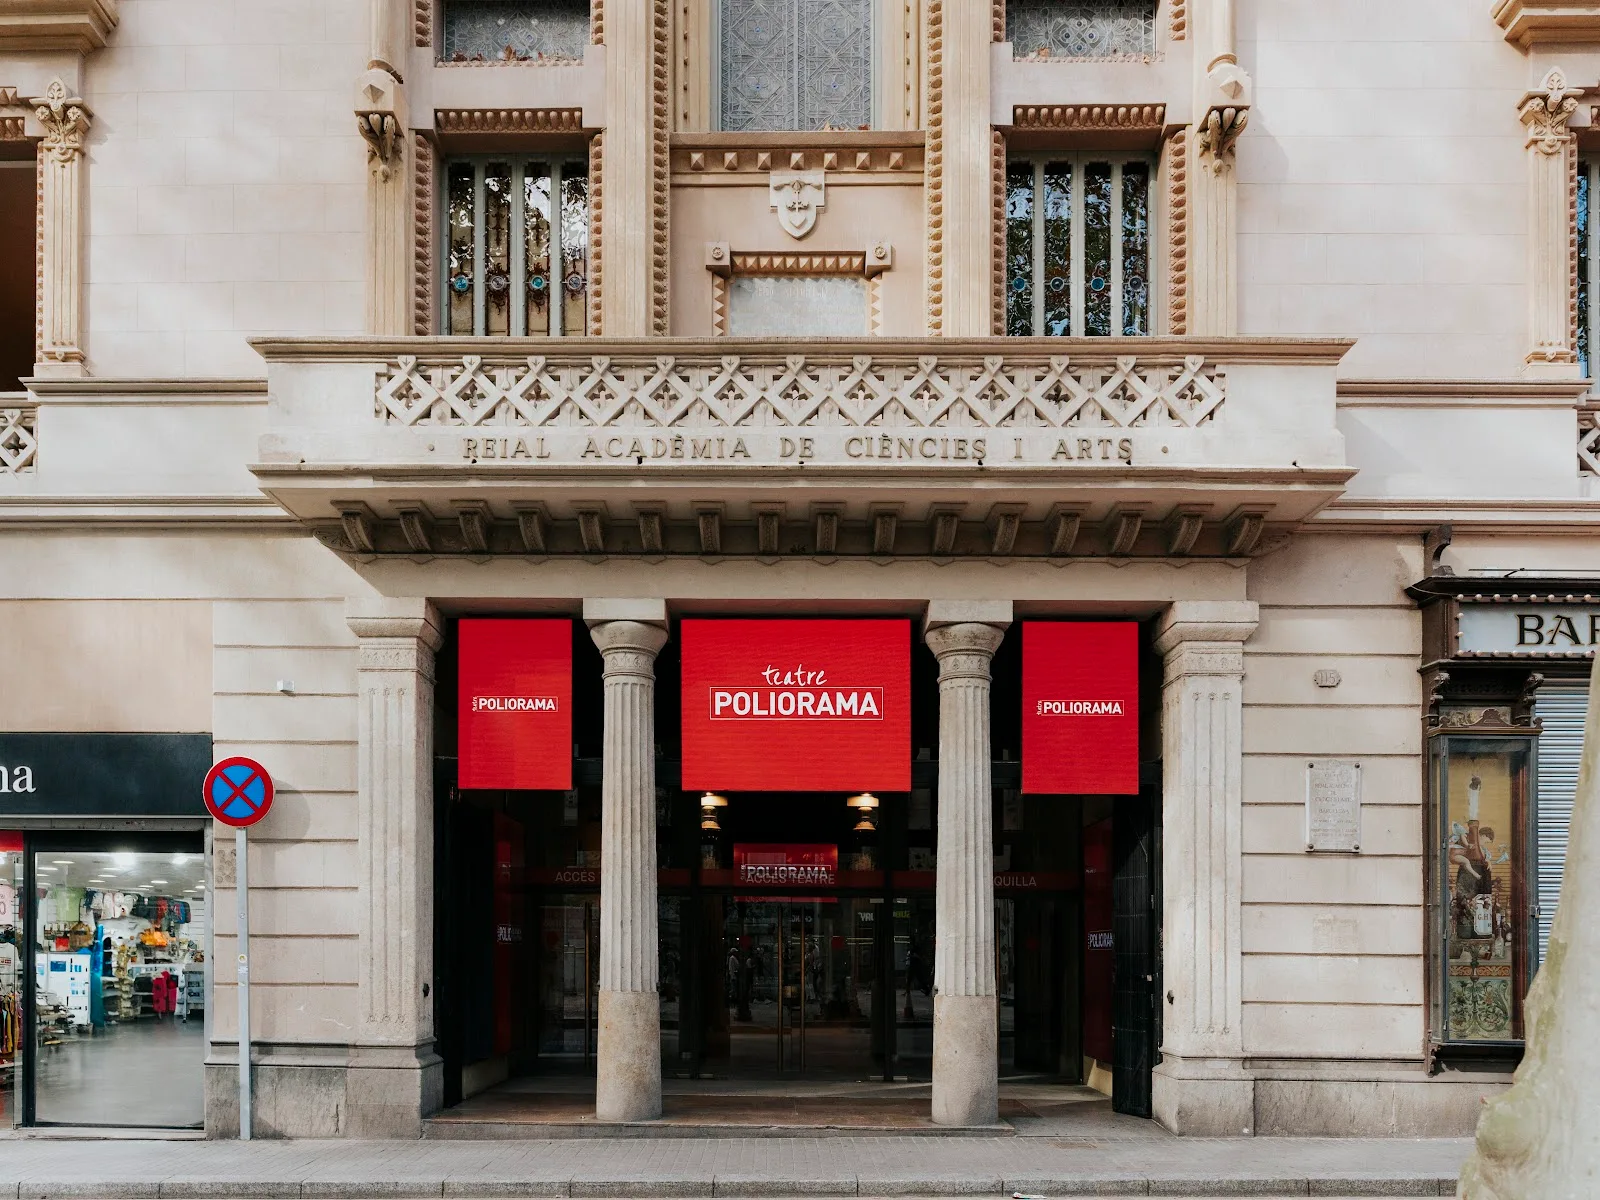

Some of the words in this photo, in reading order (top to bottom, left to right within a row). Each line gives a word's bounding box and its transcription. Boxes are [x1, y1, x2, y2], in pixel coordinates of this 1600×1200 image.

[462, 437, 550, 459] REIAL
[580, 434, 752, 459] ACADÈMIA
[780, 437, 814, 458] DE
[844, 433, 987, 460] CIÈNCIES
[1014, 437, 1023, 459] I
[1051, 437, 1133, 460] ARTS
[761, 664, 828, 687] teatre
[478, 697, 556, 711] POLIORAMA
[714, 691, 880, 716] POLIORAMA
[1043, 701, 1123, 715] POLIORAMA
[747, 866, 829, 880] POLIORAMA
